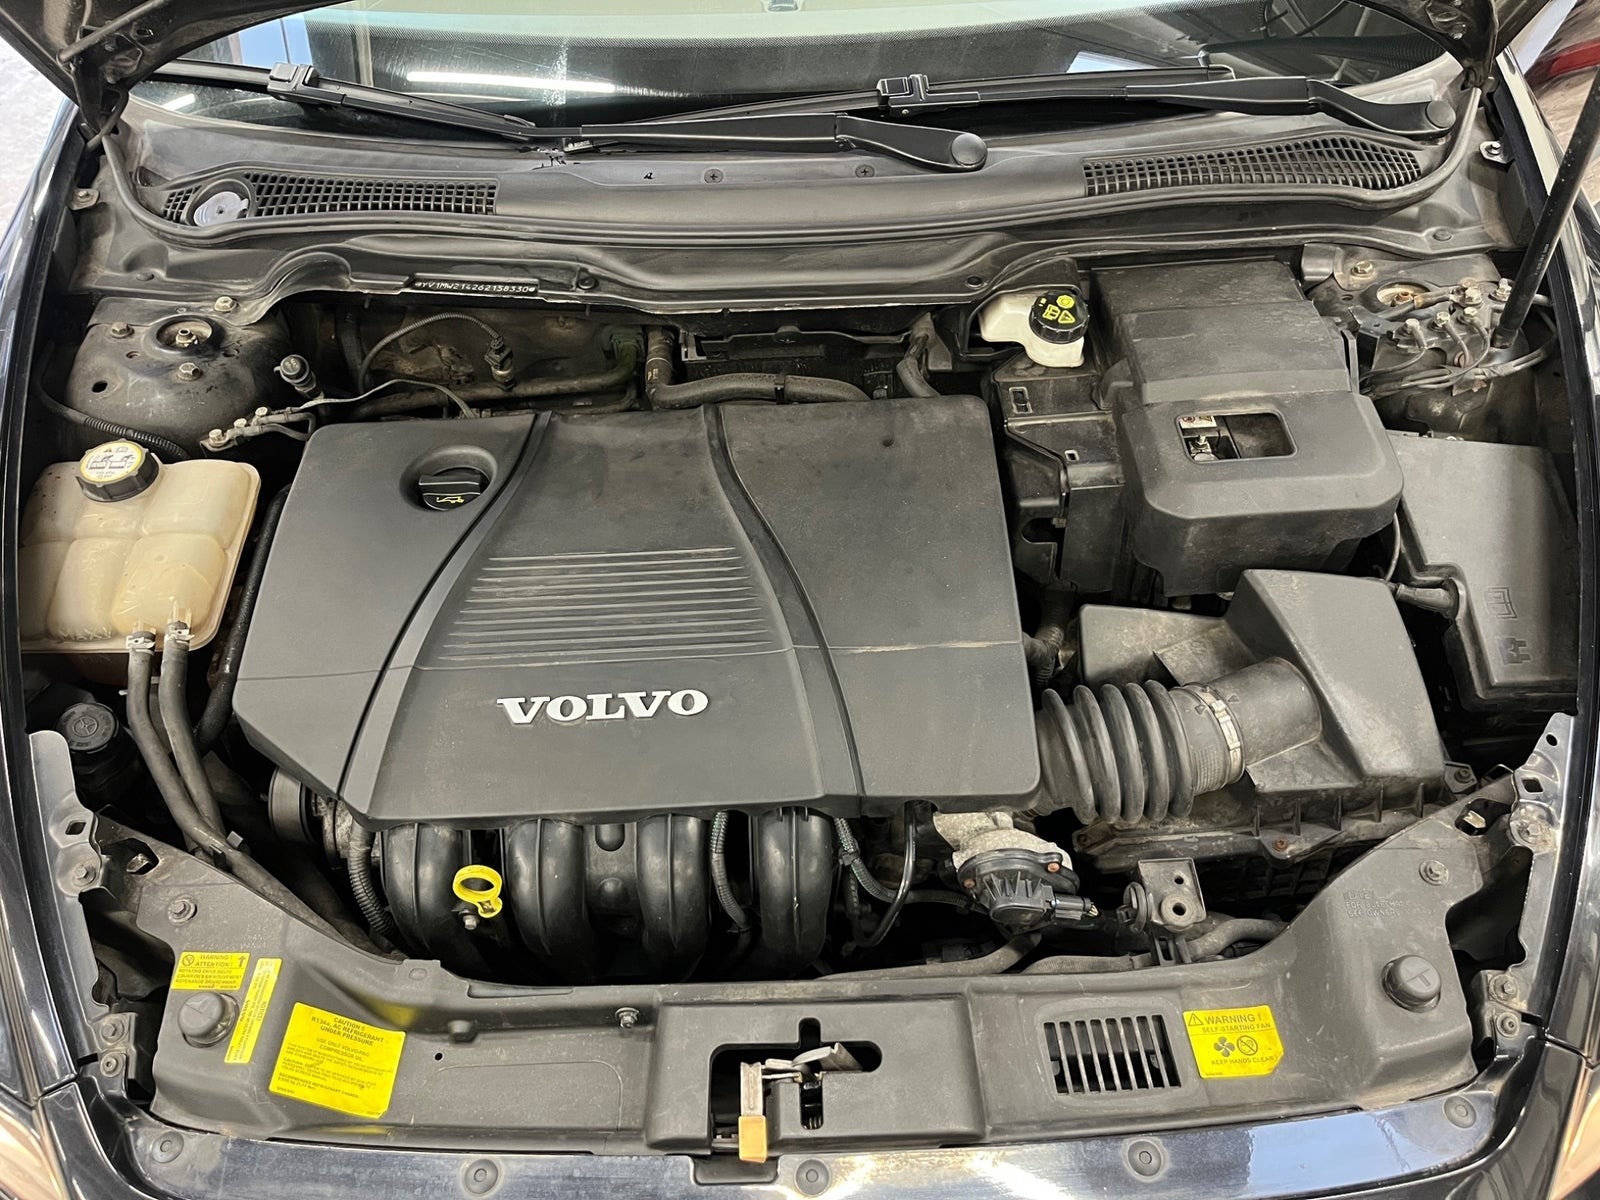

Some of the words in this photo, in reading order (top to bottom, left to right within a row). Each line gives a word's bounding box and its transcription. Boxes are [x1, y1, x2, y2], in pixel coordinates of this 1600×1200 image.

[497, 689, 709, 725] VOLVO
[333, 1017, 361, 1030] CAUTION
[1204, 1013, 1255, 1025] WARNING
[320, 1025, 342, 1037] UNDER
[342, 1032, 375, 1046] PRESSURE
[343, 1026, 385, 1043] REFRIGERANT
[319, 1044, 354, 1059] COMPRESSOR
[1229, 1057, 1252, 1065] HANDS
[1252, 1055, 1274, 1064] CLEAR
